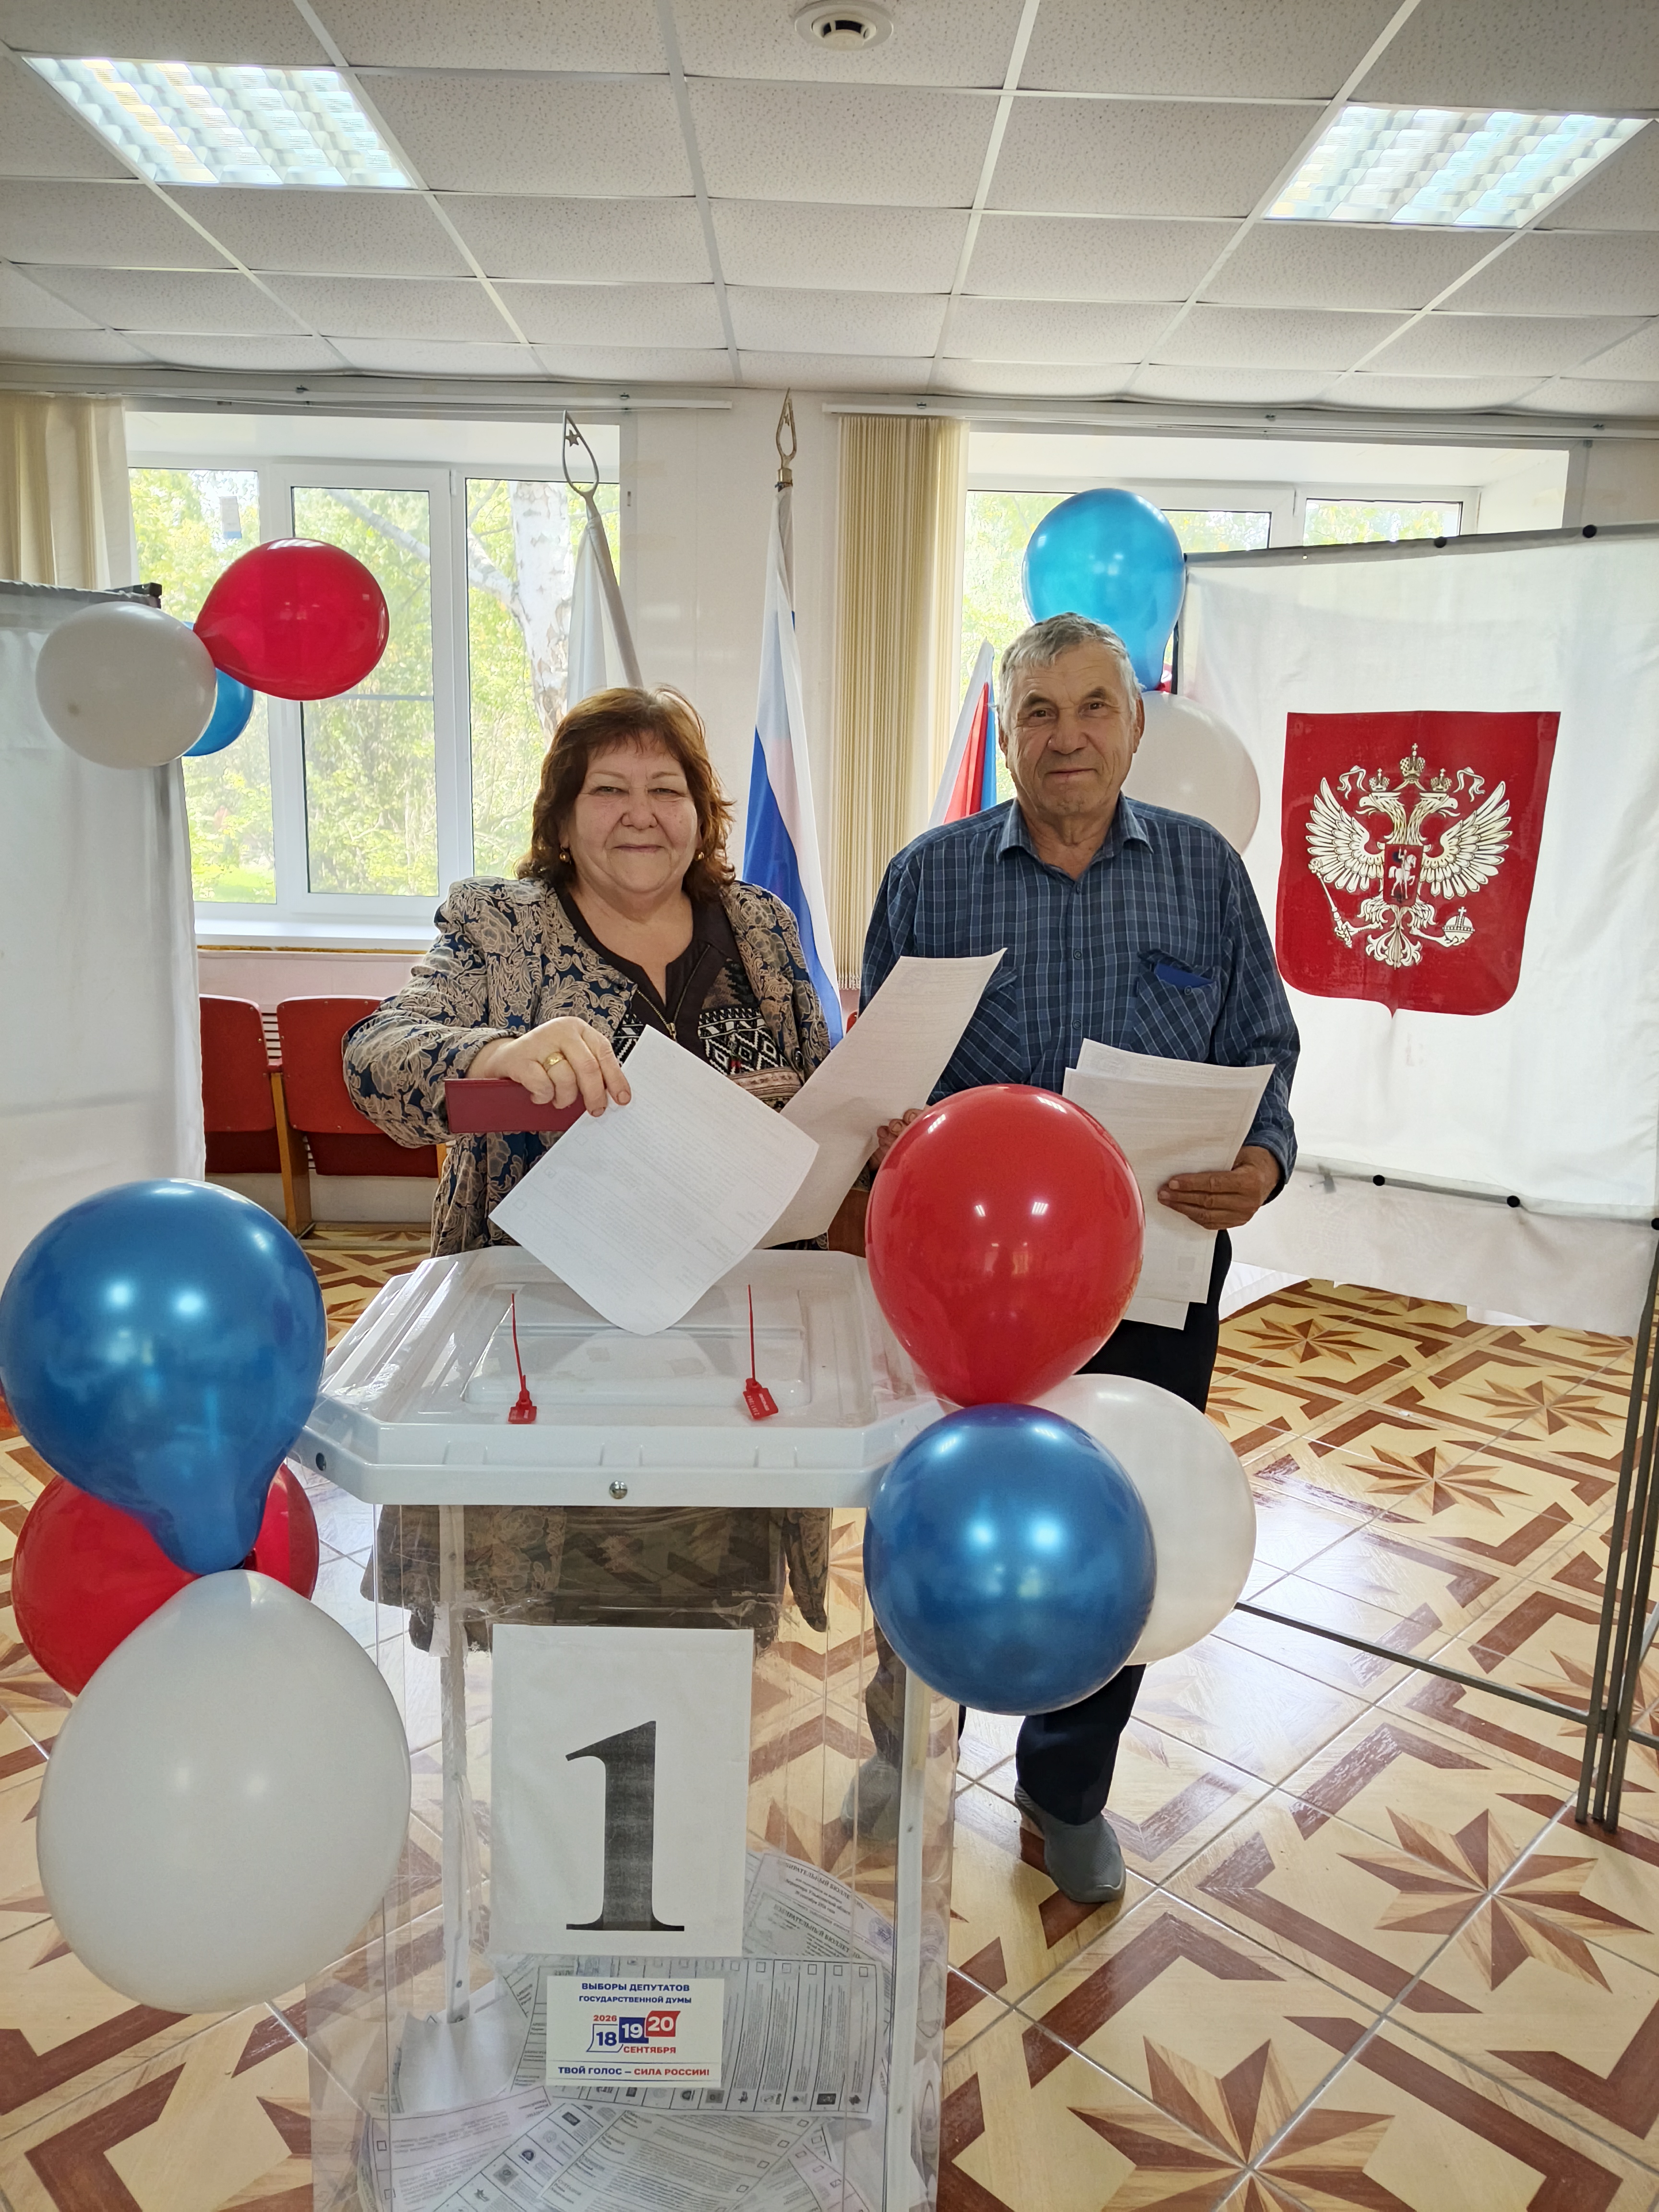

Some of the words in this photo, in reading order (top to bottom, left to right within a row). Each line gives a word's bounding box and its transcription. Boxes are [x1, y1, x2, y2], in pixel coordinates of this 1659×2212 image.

[565, 1720, 685, 1932] 1
[581, 1983, 627, 1991] ВЫБОРЫ
[629, 1984, 690, 1992] ДЕПУТАТОВ
[579, 1995, 663, 2004] ГОСУДАРСТВЕННОЙ
[596, 2032, 617, 2046] 18
[621, 2023, 643, 2039] 19
[647, 2016, 674, 2032] 20
[558, 2066, 586, 2075] ТВОЙ
[634, 2068, 662, 2076] СИЛА
[664, 2068, 709, 2077] РОССИИ!
